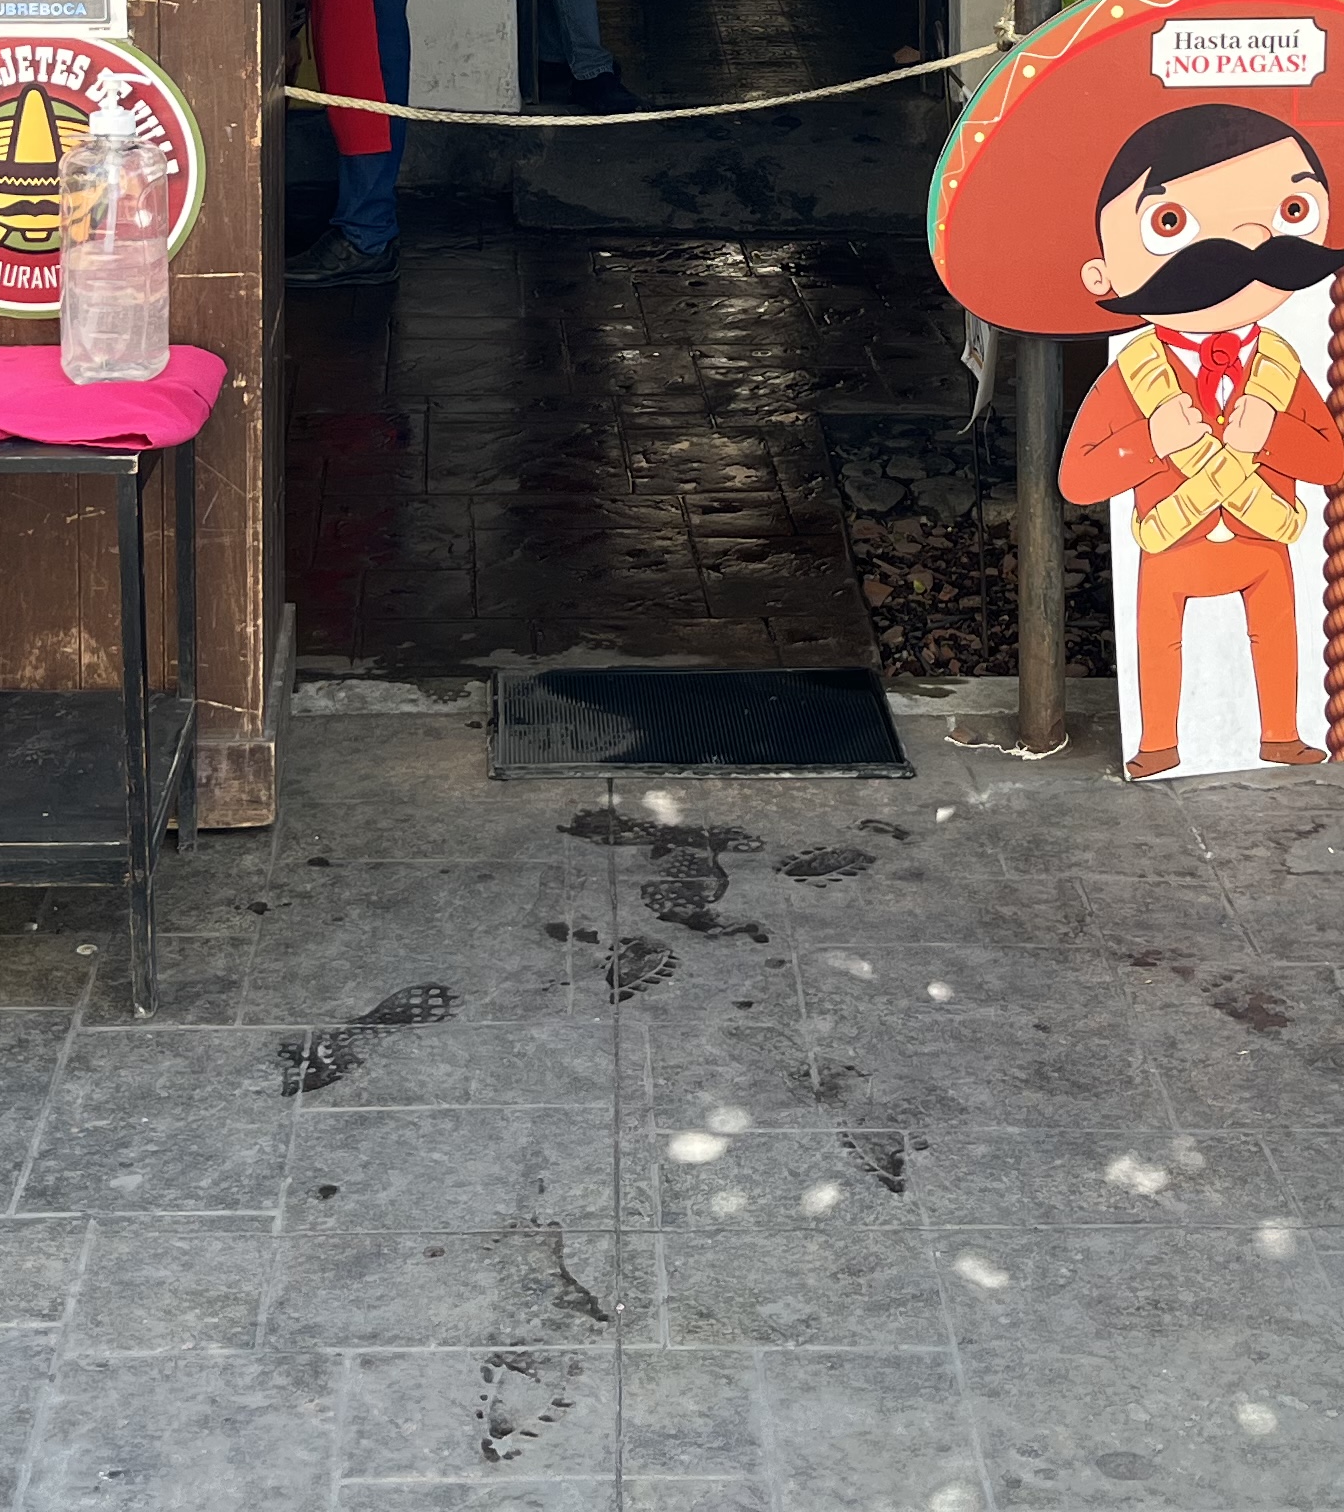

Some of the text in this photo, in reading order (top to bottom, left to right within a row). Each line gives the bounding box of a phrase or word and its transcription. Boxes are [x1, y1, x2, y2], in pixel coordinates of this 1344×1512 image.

[1173, 29, 1301, 54] Hasta aquí
[1165, 54, 1308, 79] ¡NO PAGAS!
